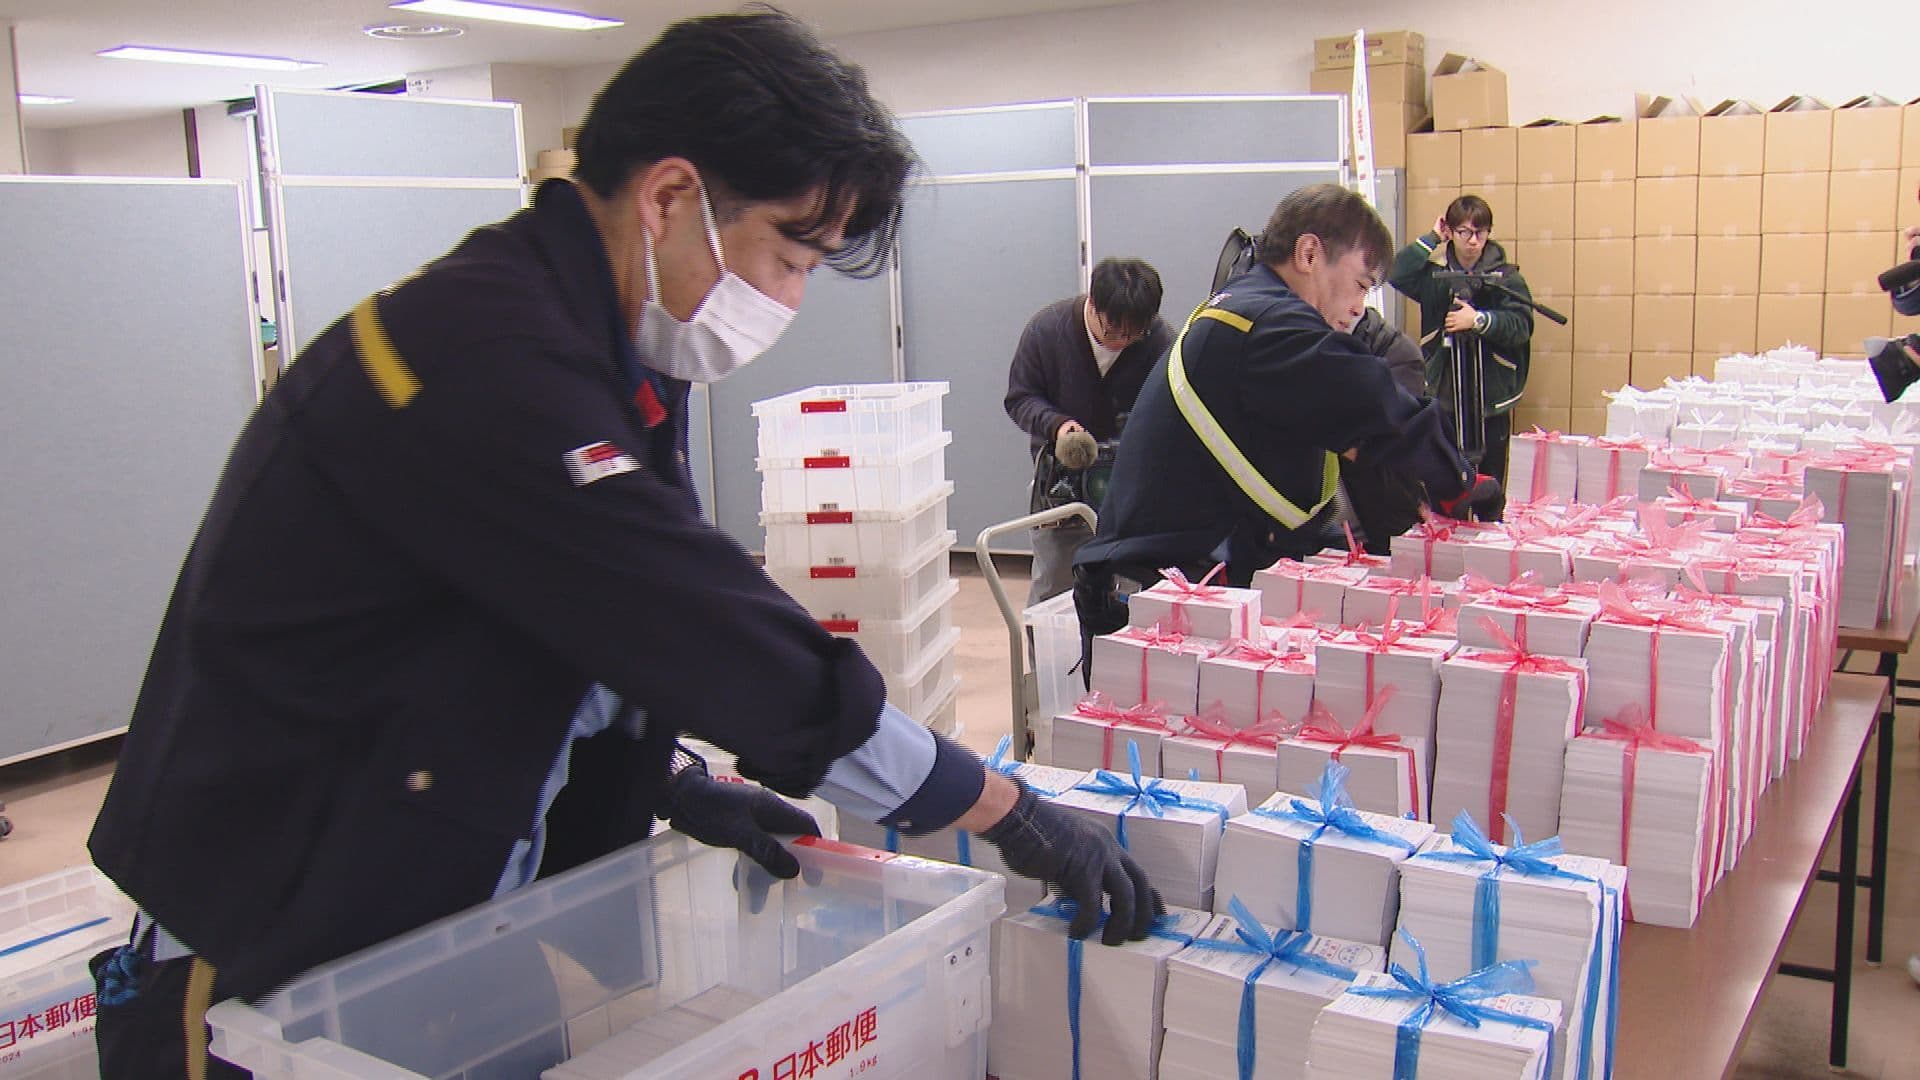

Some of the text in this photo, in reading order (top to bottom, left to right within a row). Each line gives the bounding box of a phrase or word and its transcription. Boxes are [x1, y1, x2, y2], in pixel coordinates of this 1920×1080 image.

[0, 992, 96, 1050] 日本郵便
[773, 1005, 878, 1080] 日本郵便
[0, 1050, 20, 1063] 024
